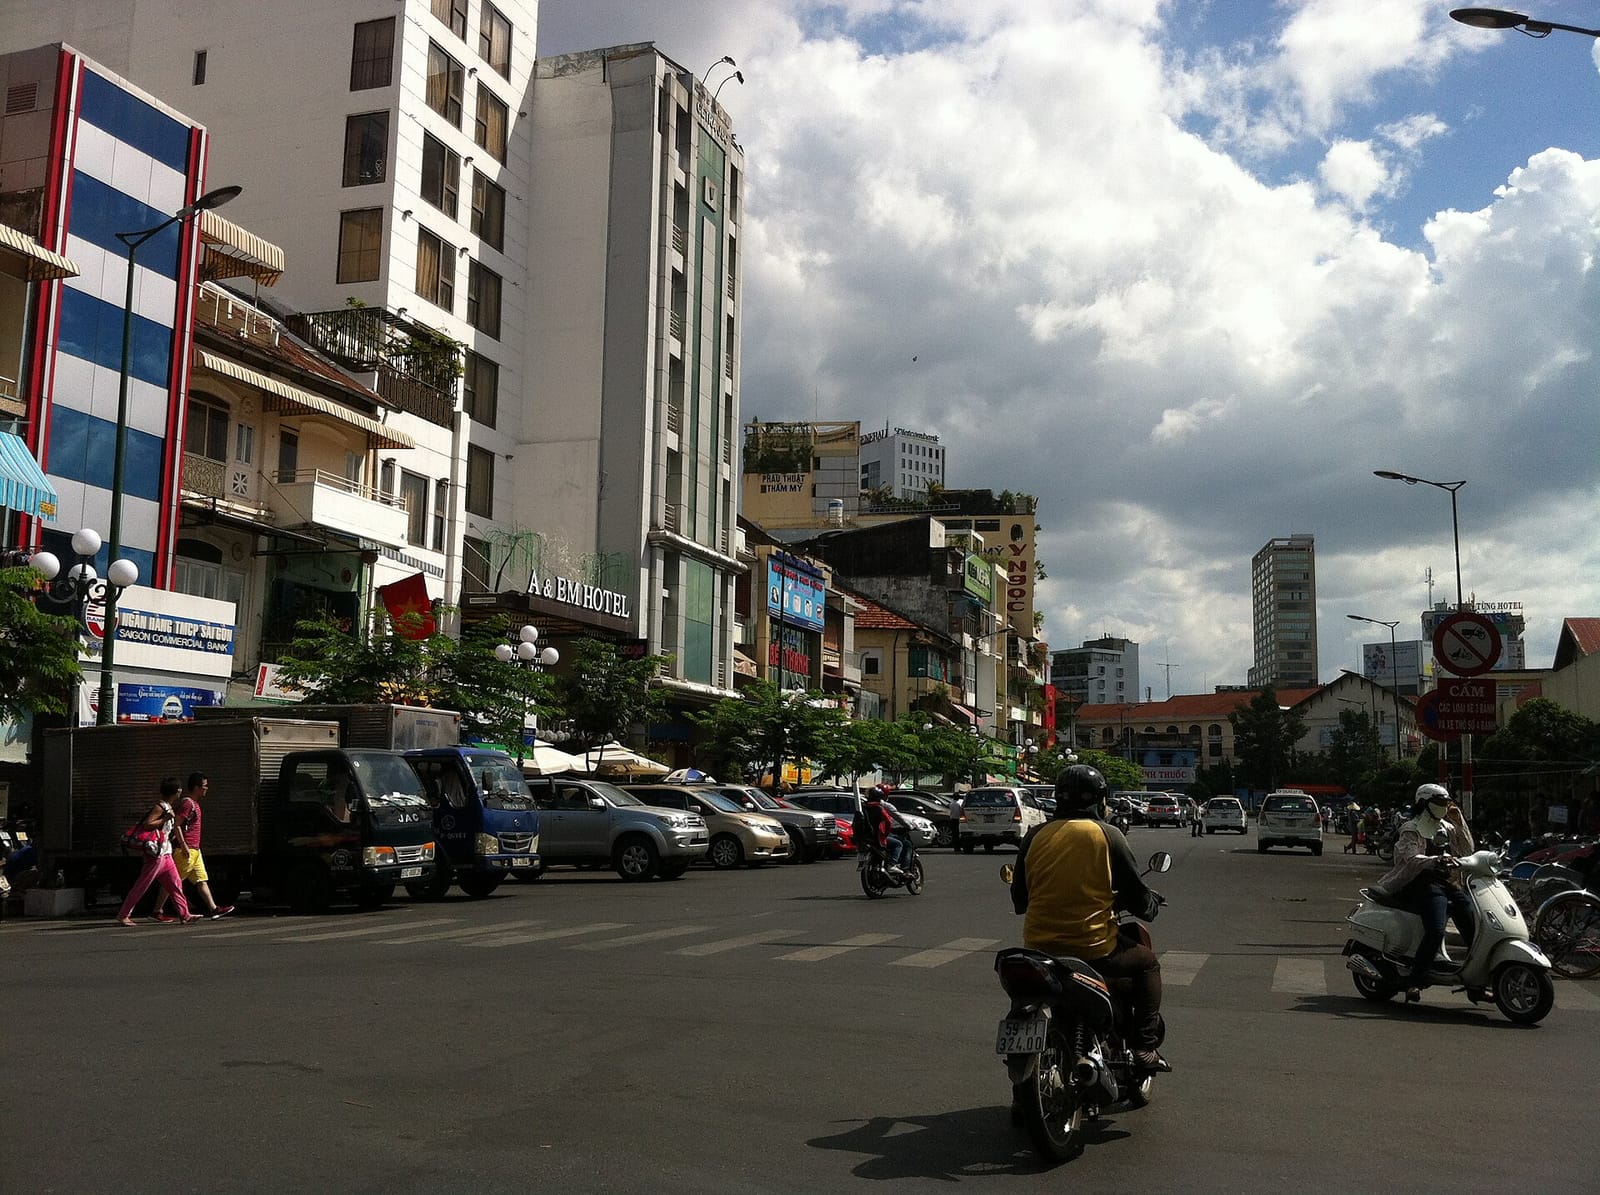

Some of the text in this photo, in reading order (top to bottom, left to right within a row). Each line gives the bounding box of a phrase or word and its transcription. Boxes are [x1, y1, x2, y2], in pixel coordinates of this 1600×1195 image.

[528, 569, 630, 618] A & EM HOTEL
[1497, 601, 1523, 610] HOTEL
[121, 611, 233, 642] NGÂN HÀNG TMCP SÀI GÒN
[119, 628, 228, 652] SAIGON COMMERCIAL BANK
[1449, 681, 1485, 697] CẤM
[1159, 768, 1186, 778] THUỐC
[398, 813, 419, 823] JAC
[1000, 1036, 1043, 1052] 324.00
